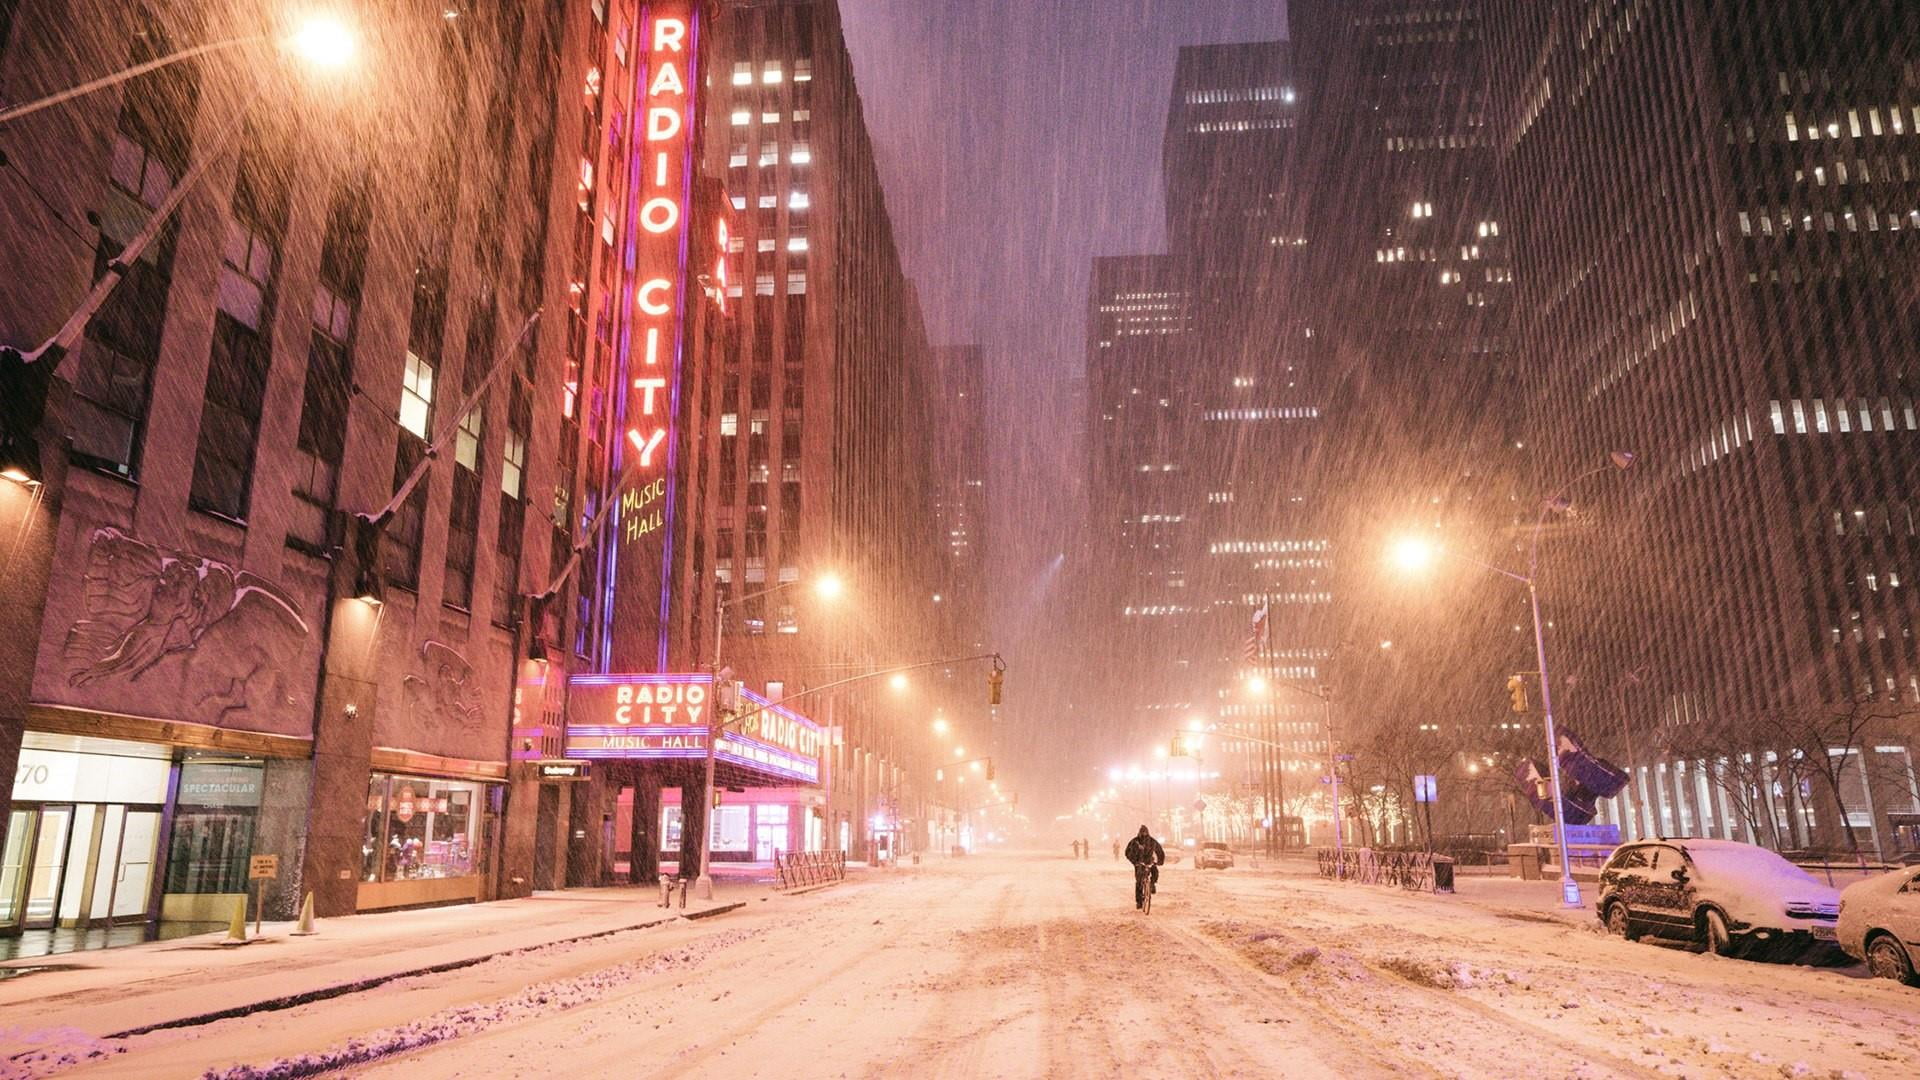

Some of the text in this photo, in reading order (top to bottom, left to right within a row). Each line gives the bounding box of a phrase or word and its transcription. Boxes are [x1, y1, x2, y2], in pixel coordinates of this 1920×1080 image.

[628, 18, 686, 467] RADIO CITY
[622, 478, 665, 518] MUSIC
[626, 509, 663, 545] HALL
[616, 685, 705, 705] RADIO
[615, 705, 703, 725] CITY
[602, 735, 704, 749] MUSIC HALL
[761, 709, 797, 750] RADIO
[799, 726, 820, 758] CITY
[16, 764, 49, 785] 70
[183, 783, 256, 793] SPECTACULAR
